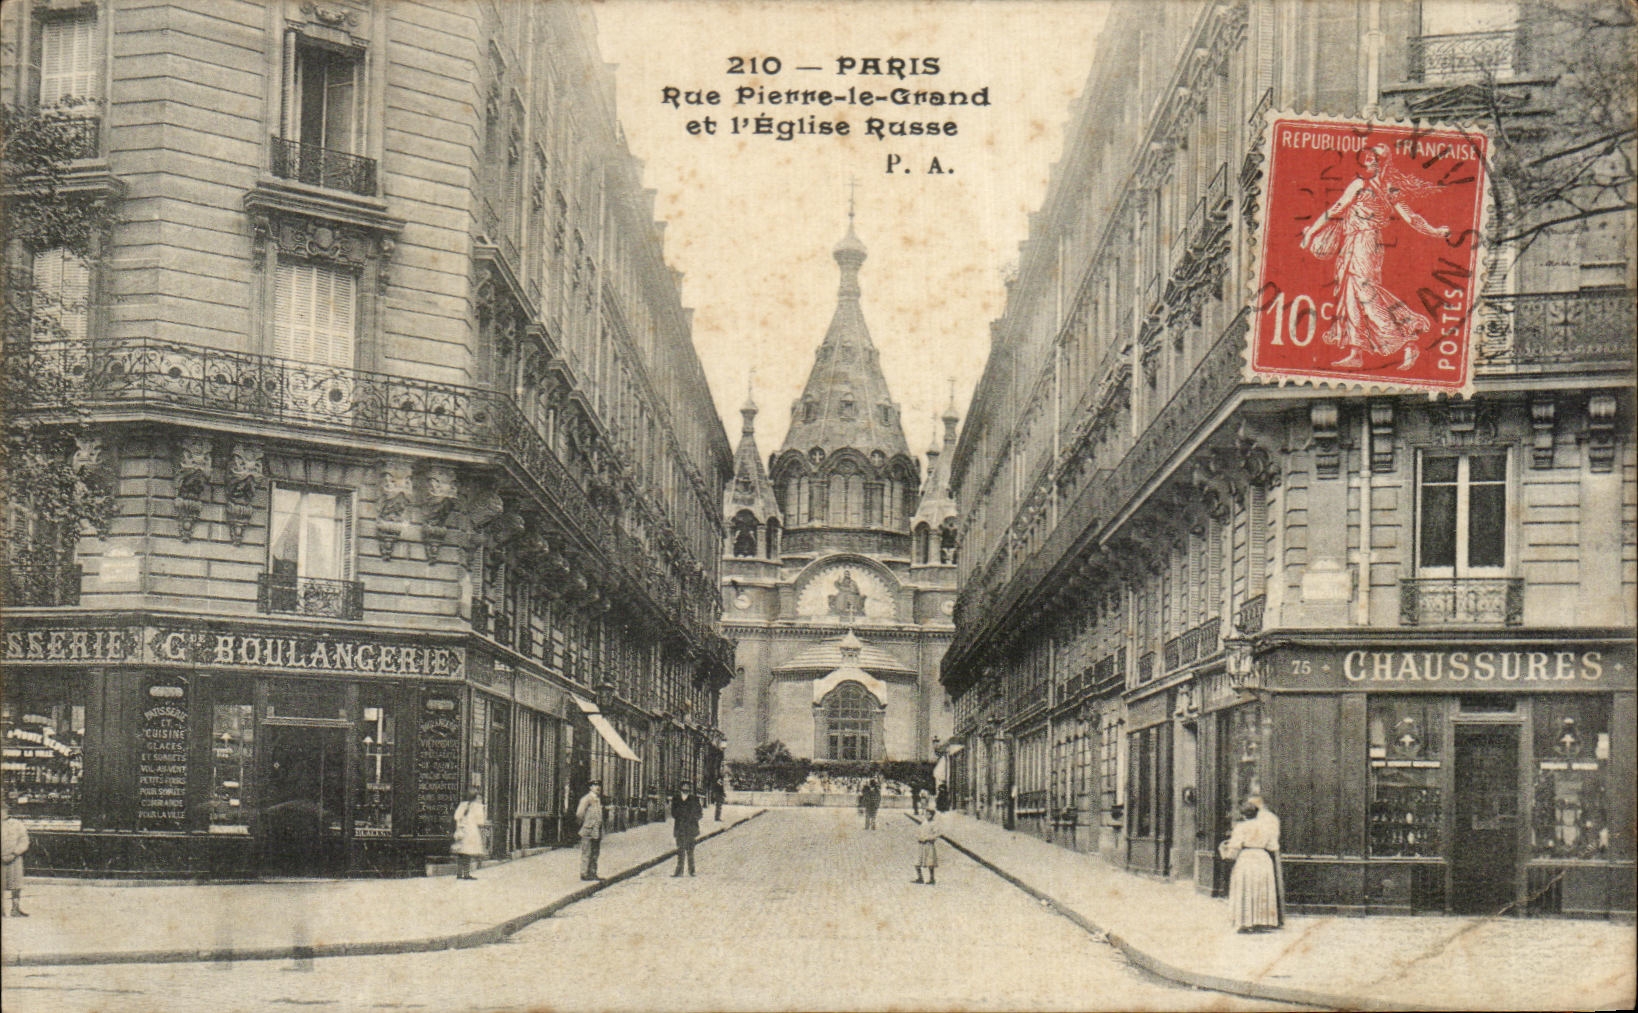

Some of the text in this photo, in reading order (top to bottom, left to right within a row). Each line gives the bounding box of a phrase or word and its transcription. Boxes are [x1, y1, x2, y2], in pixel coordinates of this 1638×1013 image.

[1266, 292, 1317, 347] 10
[1438, 289, 1463, 371] POSTES
[2, 631, 124, 660] SSERIE
[213, 635, 452, 676] BOULANGERIE
[1290, 650, 1603, 682] 75 CHAUSSURES
[145, 729, 185, 739] CUISINE
